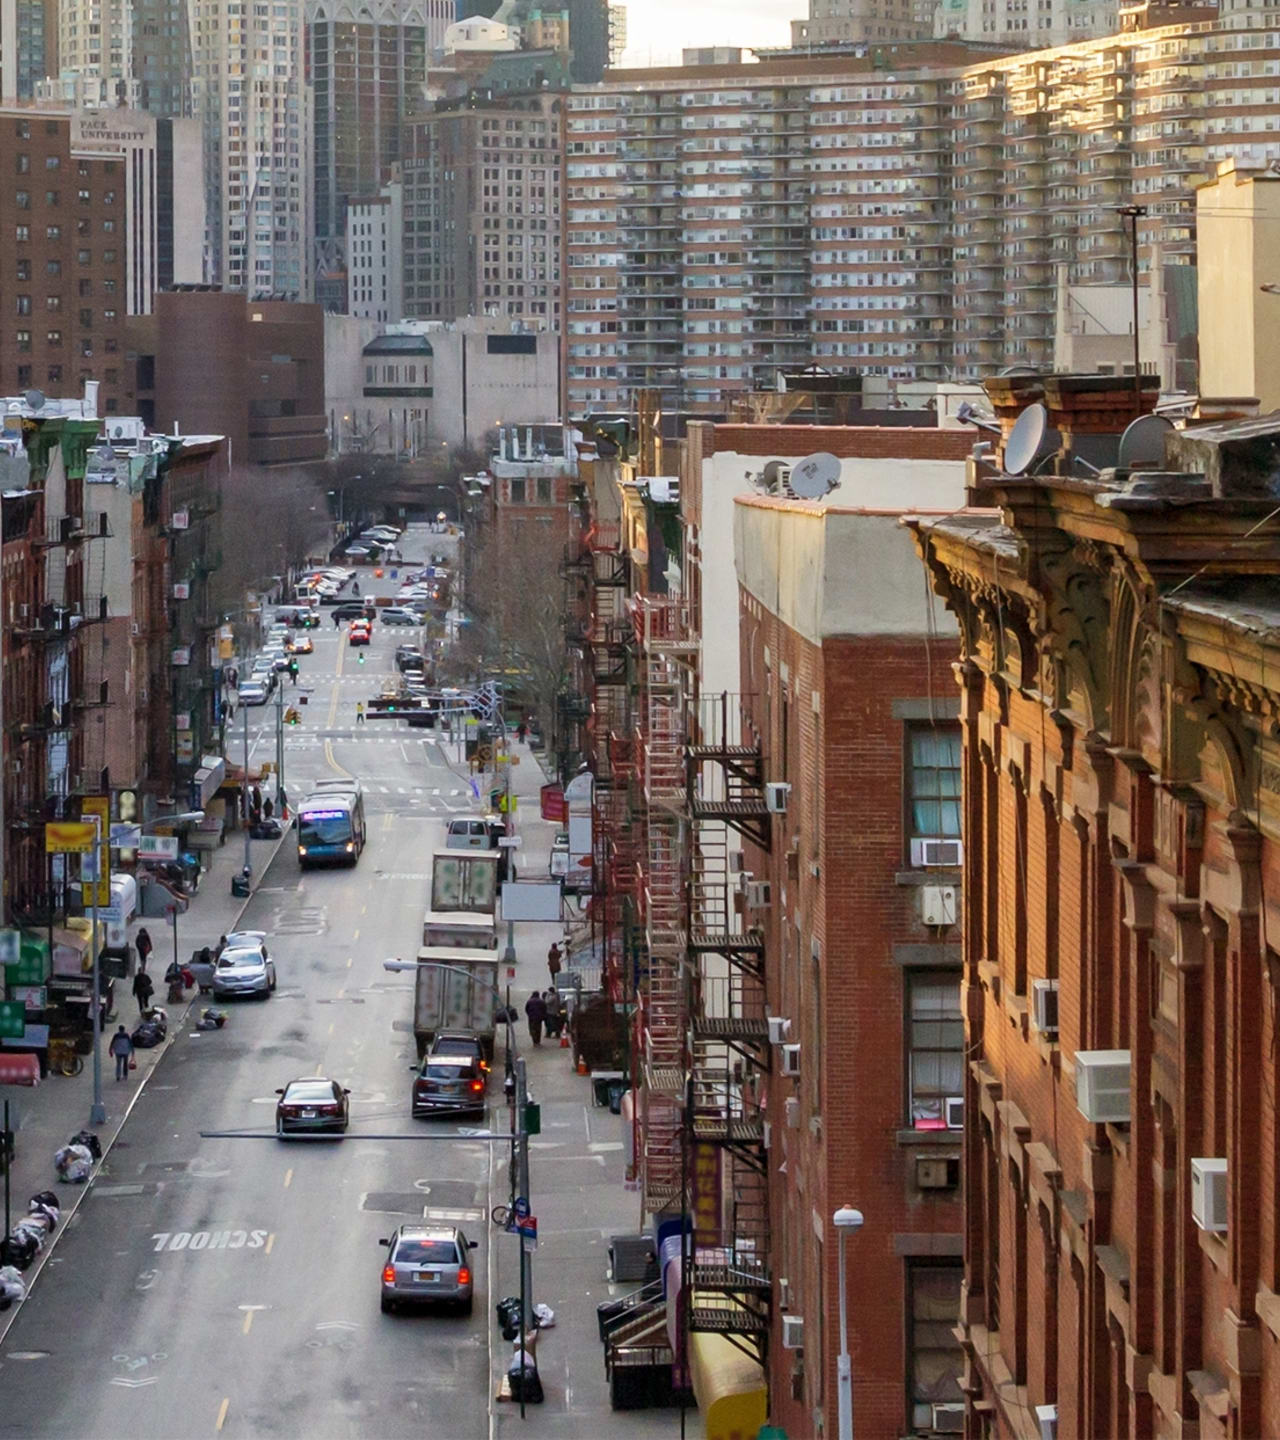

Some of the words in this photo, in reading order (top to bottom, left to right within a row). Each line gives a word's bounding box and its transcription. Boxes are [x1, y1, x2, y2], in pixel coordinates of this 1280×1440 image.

[80, 121, 108, 129] PACE
[81, 131, 144, 140] UNIVERSITY
[150, 1229, 268, 1252] SCHOOL
